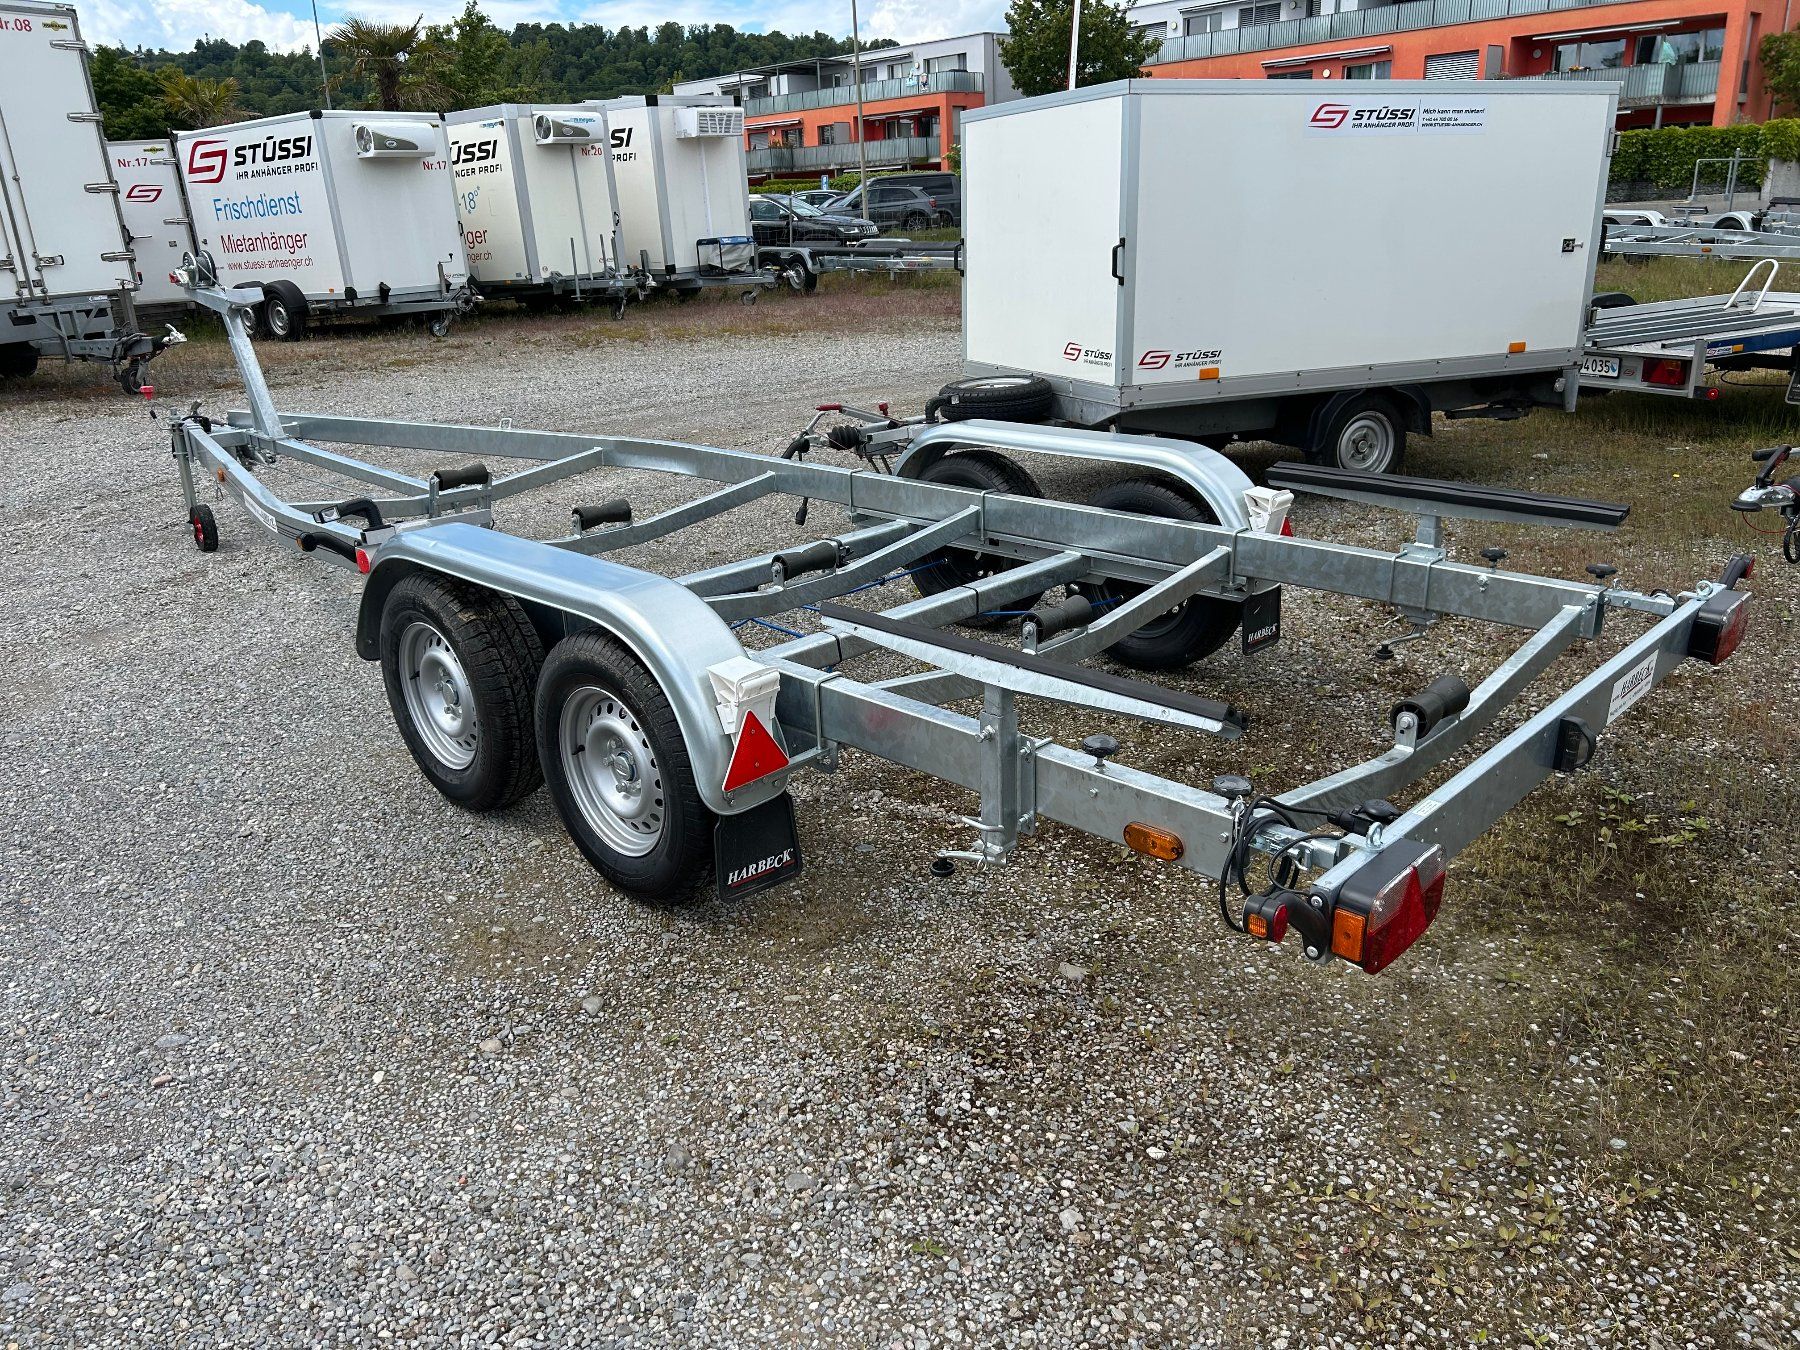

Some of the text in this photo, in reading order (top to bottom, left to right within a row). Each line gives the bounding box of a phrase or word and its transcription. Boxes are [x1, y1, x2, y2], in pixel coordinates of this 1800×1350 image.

[1352, 106, 1416, 120] STÜSSI
[1363, 121, 1396, 129] ANHÄNGER
[234, 135, 312, 166] STÜSSI
[117, 157, 148, 167] Nr.17
[423, 160, 447, 171] Nr.17
[478, 163, 502, 174] PROFI
[236, 162, 318, 180] IHR ANHÄNGER PROFI
[213, 190, 302, 221] Frischdienst
[220, 231, 308, 254] Mietanhänger
[228, 256, 314, 270] www.stuessi-anhaenger.ch
[1084, 349, 1112, 360] STÜSSI
[1175, 350, 1222, 361] STÜSSI
[1247, 623, 1278, 642] HARBECK
[727, 849, 793, 885] HARBECK
